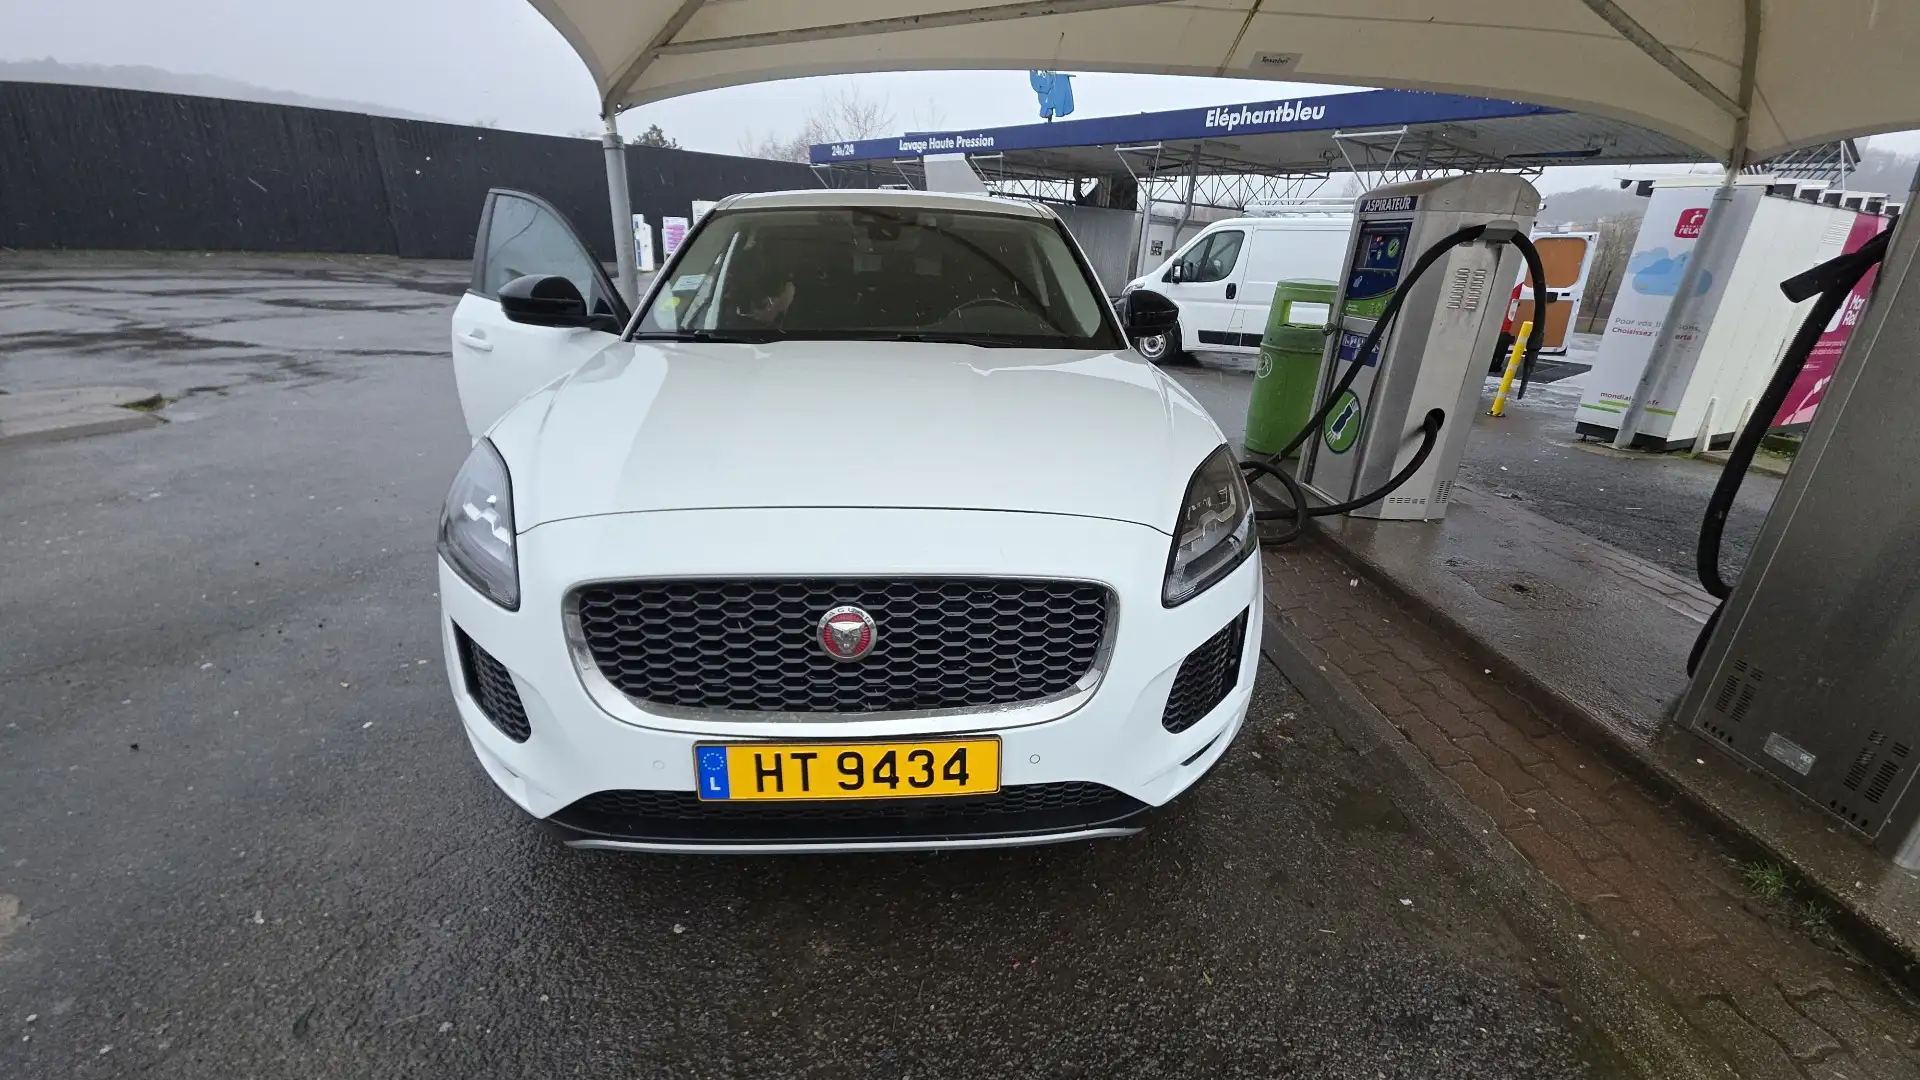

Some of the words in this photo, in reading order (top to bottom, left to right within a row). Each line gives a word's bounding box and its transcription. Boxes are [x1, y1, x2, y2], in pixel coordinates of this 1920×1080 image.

[1205, 101, 1326, 131] Eléphantbleu
[899, 139, 928, 153] Lavage
[929, 137, 954, 149] Haute
[956, 134, 994, 148] Pression
[1365, 196, 1412, 212] ASPIRATEUR
[1615, 317, 1635, 325] Pour
[1612, 327, 1652, 337] Choisissez
[754, 752, 818, 792] HT
[837, 747, 970, 791] 9434
[709, 776, 721, 791] L
